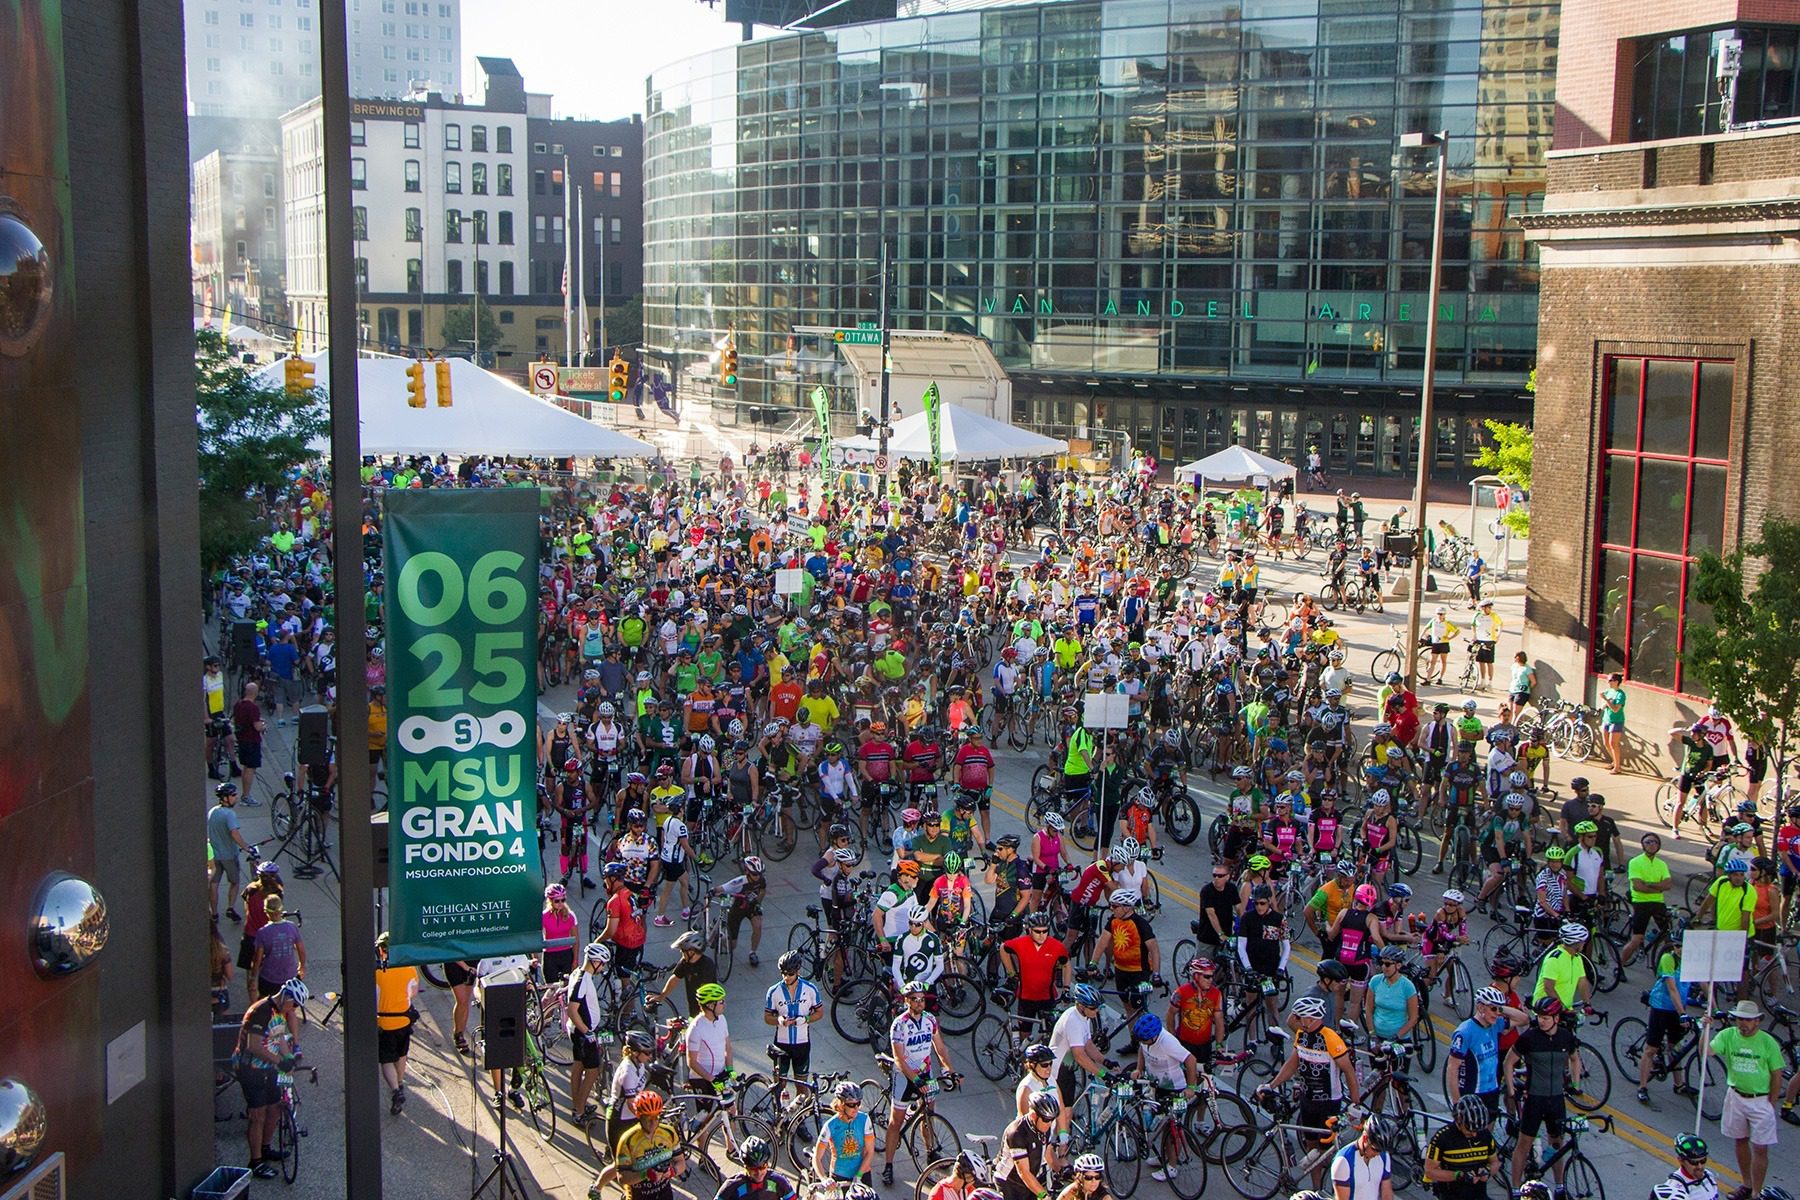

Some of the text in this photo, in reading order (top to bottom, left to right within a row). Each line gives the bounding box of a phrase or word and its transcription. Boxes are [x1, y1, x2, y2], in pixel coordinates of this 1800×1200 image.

[353, 104, 404, 116] BREWING
[984, 298, 1497, 321] VAN ANDEL ARENA
[567, 370, 595, 380] Tickets
[397, 550, 527, 627] 06
[407, 631, 527, 708] 25
[454, 719, 472, 745] S
[403, 754, 521, 802] MSU
[401, 800, 524, 839] GRAN
[405, 836, 525, 864] FONDO 4
[405, 864, 527, 879] MSUGRANFONDO.COM
[422, 900, 511, 914] MICHIGAN STATE
[422, 911, 511, 925] UNIVERSITY
[480, 925, 510, 933] Medicine
[910, 955, 925, 970] S
